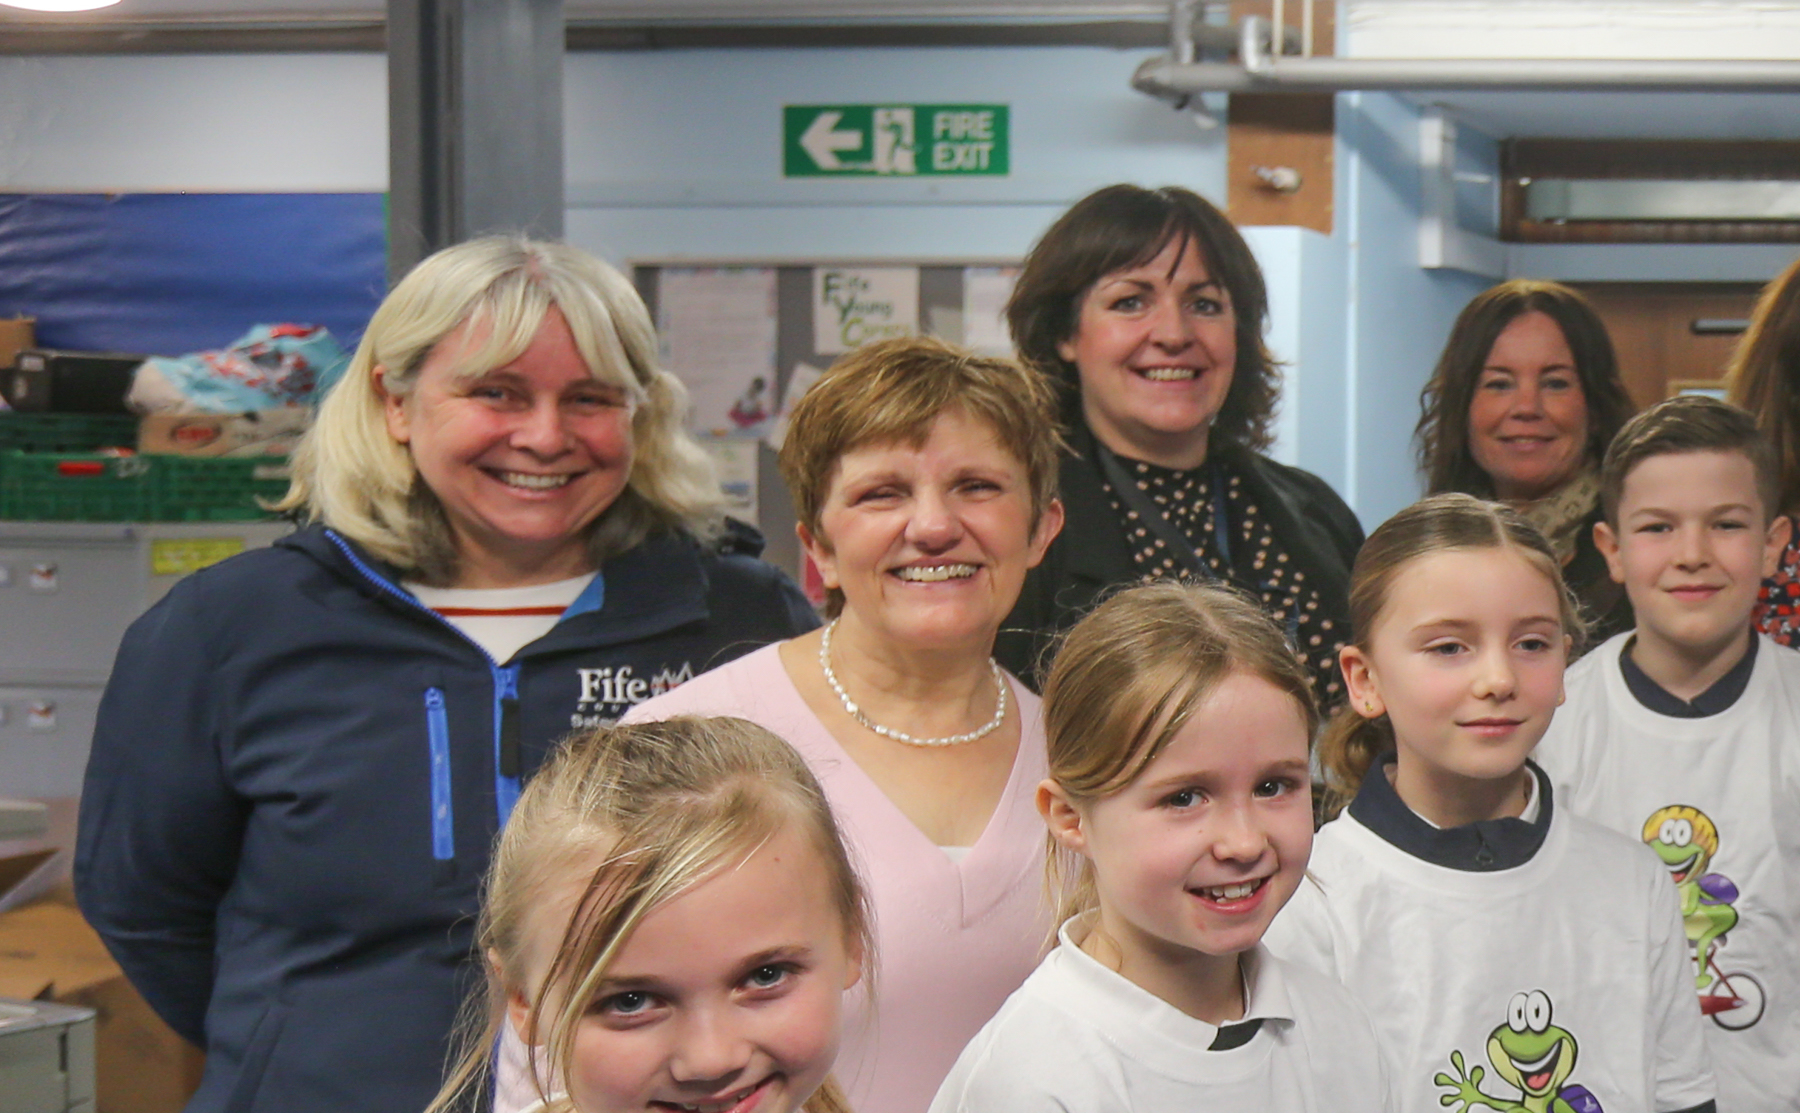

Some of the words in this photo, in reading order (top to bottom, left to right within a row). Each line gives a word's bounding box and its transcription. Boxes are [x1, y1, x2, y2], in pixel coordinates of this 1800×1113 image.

[933, 111, 994, 139] FIRE
[933, 142, 993, 170] EXIT
[823, 273, 870, 303] Fife
[832, 298, 893, 323] Young
[577, 665, 649, 704] Fife
